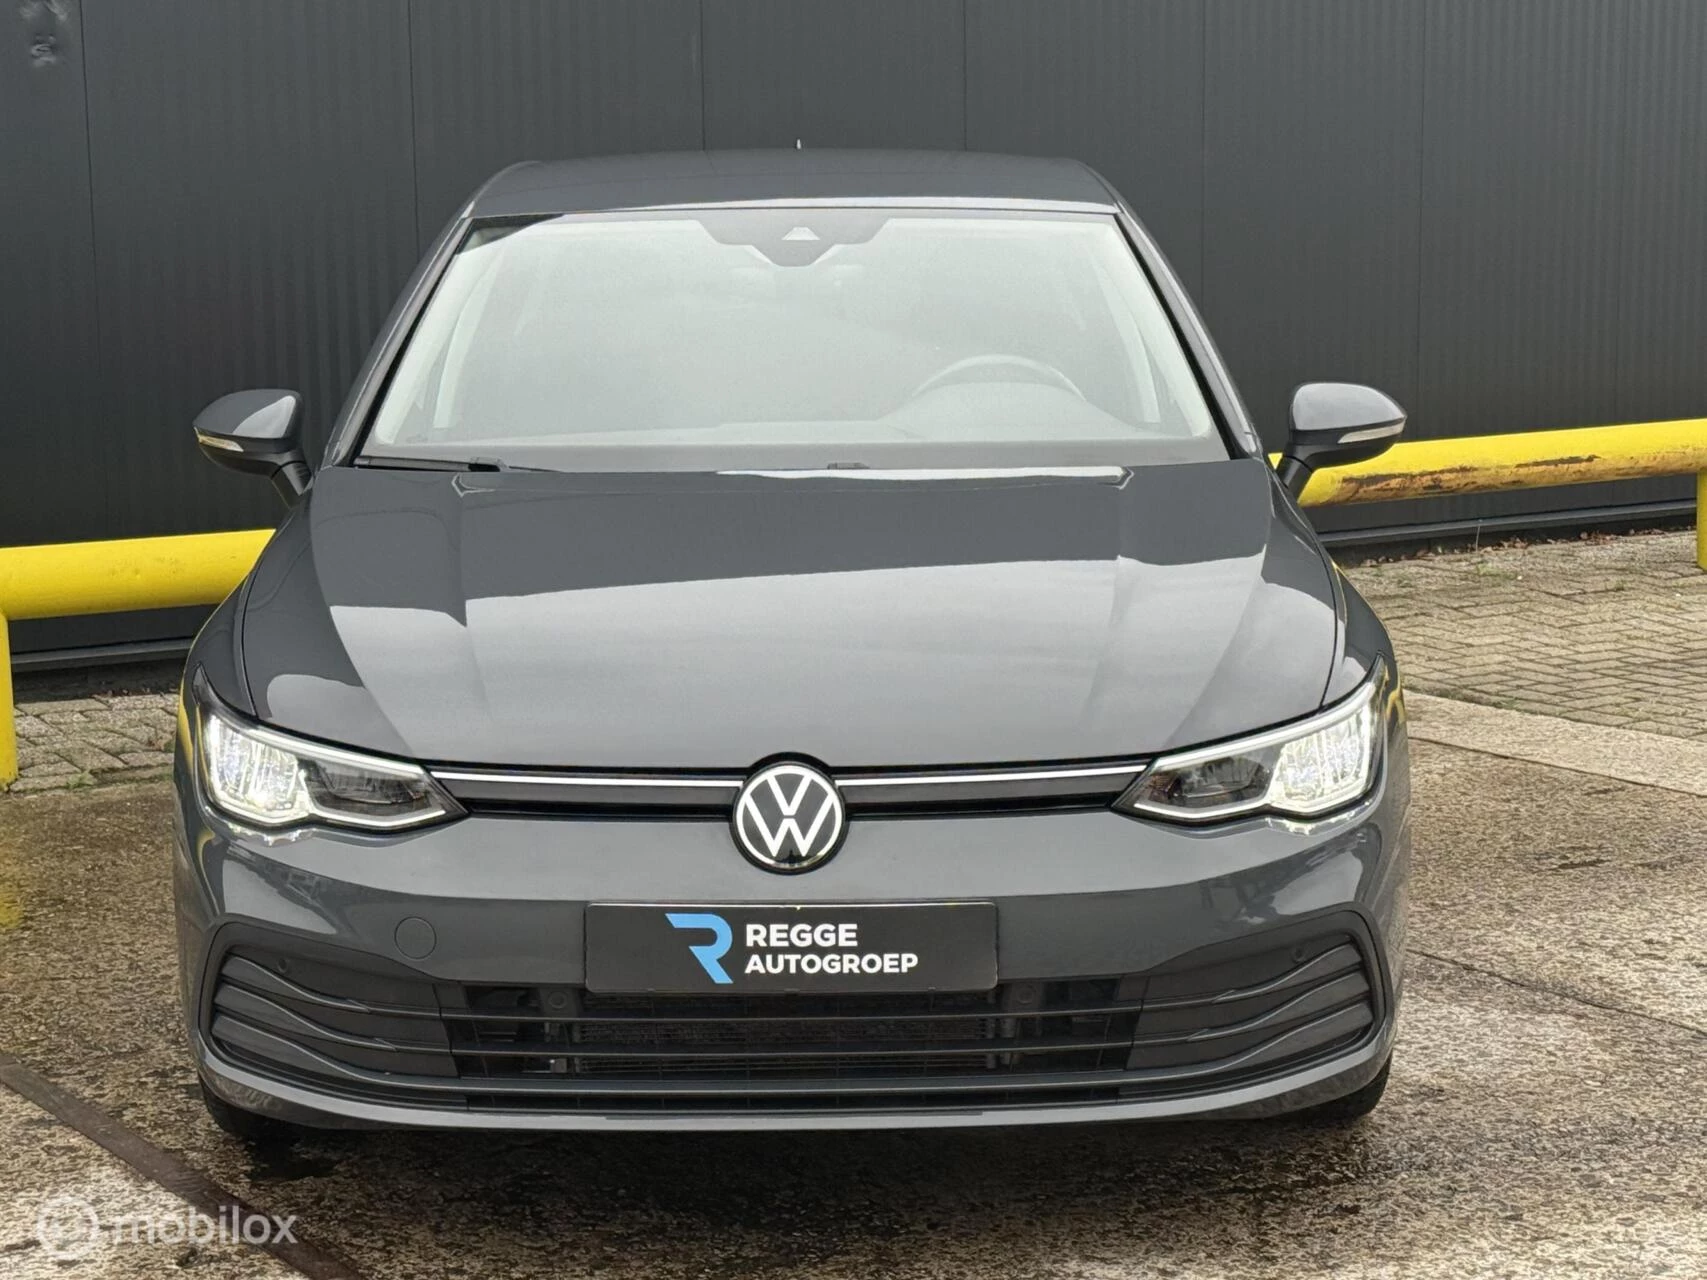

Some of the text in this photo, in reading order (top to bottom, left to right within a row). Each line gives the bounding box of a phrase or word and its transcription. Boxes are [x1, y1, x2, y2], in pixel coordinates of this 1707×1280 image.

[738, 767, 840, 858] VW
[745, 923, 858, 948] REGGE
[744, 953, 919, 974] AUTOGROEP
